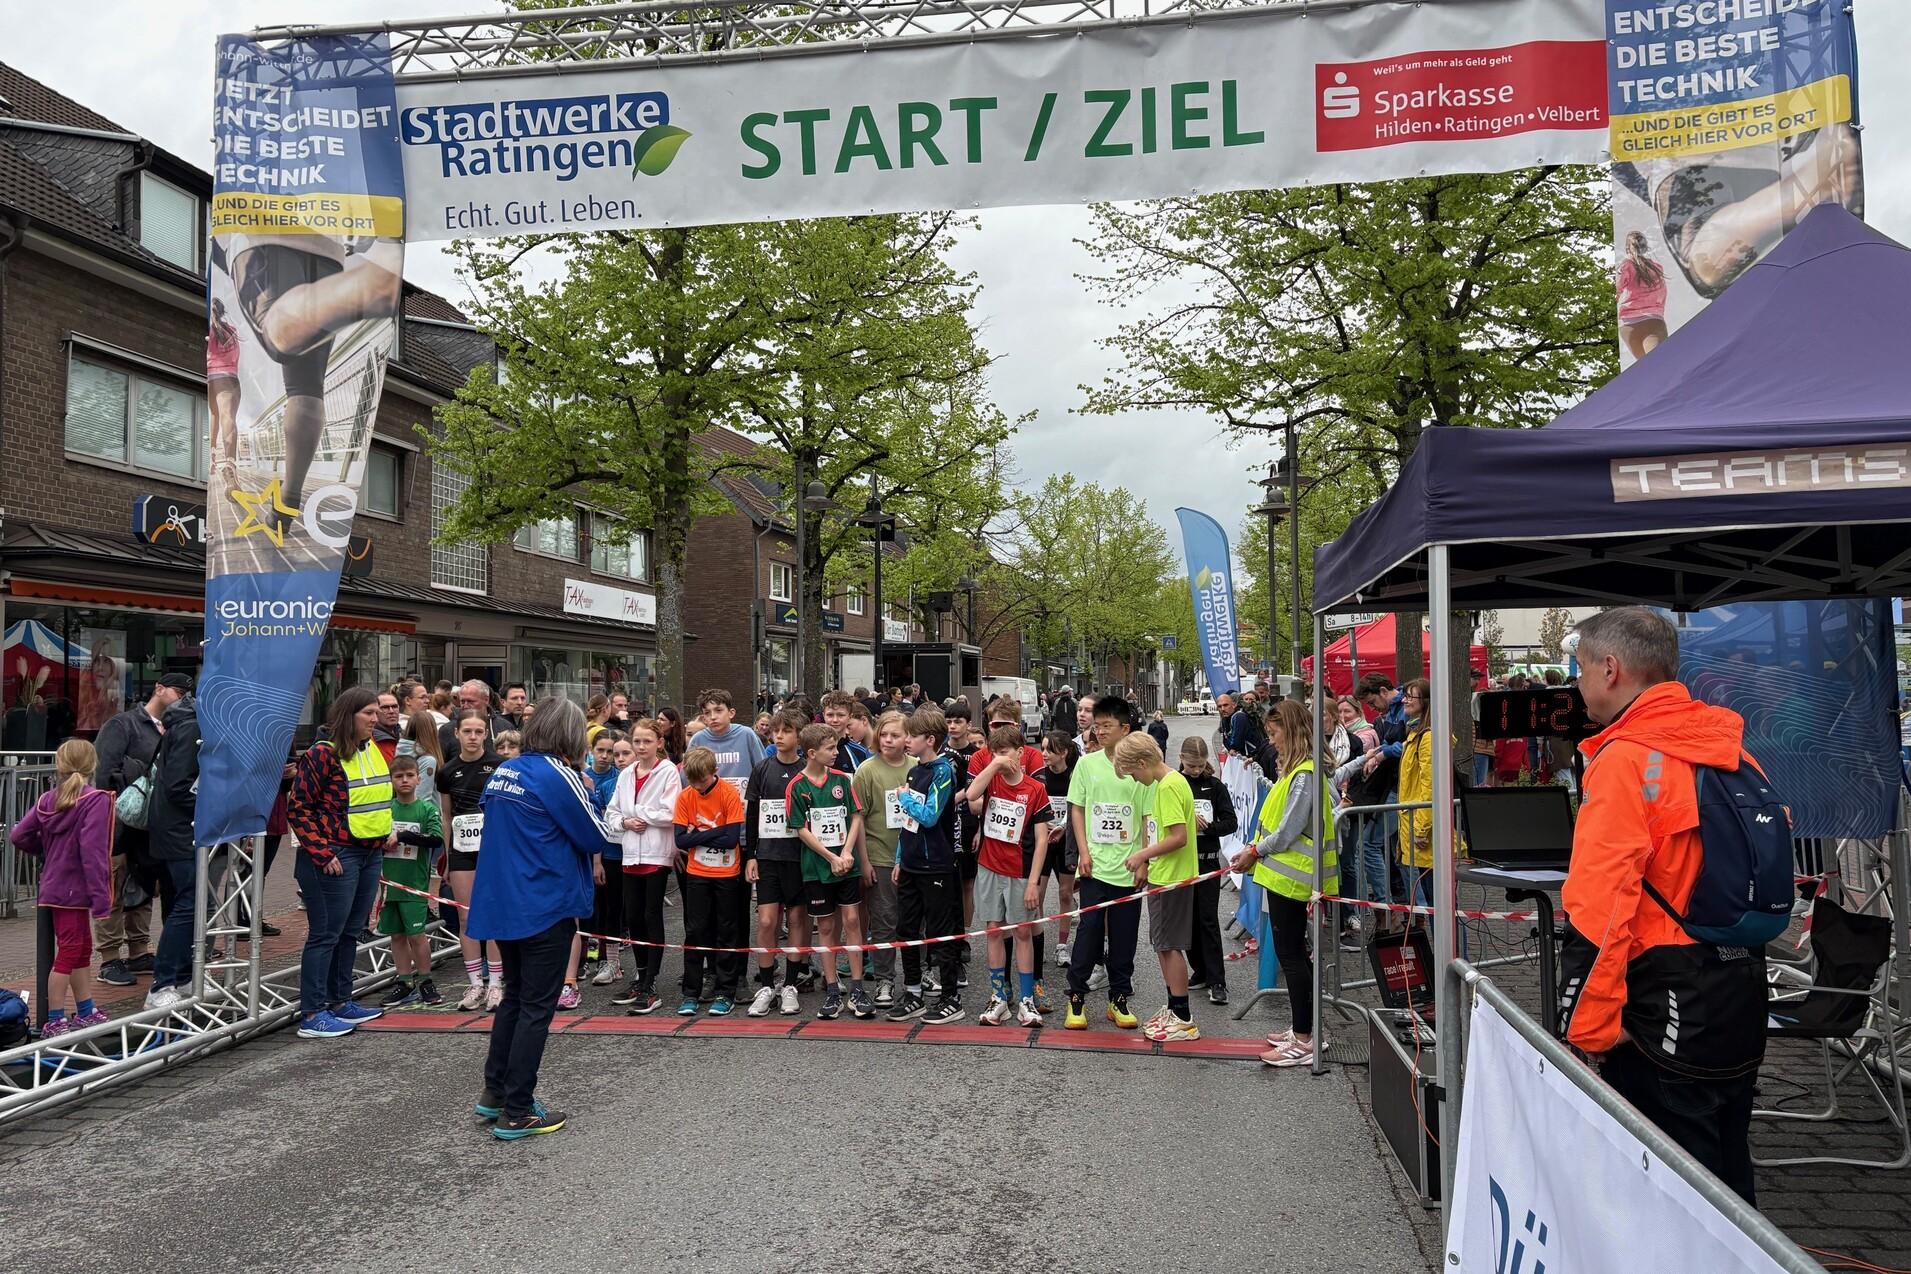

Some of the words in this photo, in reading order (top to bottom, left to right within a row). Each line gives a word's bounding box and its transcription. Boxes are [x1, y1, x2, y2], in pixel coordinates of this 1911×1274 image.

[1617, 42, 1667, 69] DIE
[1675, 27, 1781, 63] BESTE
[1374, 62, 1403, 76] Weil's
[1405, 60, 1421, 70] um
[1423, 57, 1448, 69] mehr
[1450, 57, 1463, 67] als
[1465, 56, 1487, 67] Geld
[1489, 54, 1513, 66] geht
[1618, 64, 1760, 102] TECHNIK
[1374, 83, 1514, 117] Sparkasse
[408, 94, 661, 144] Stadtwerke
[740, 96, 998, 180] START
[1024, 93, 1057, 162] /
[1084, 80, 1265, 158] ZIEL
[1375, 118, 1432, 139] Hilden
[1444, 111, 1525, 133] Ratingen
[1537, 105, 1601, 122] Velbert
[1622, 118, 1670, 135] ...UND
[1675, 114, 1701, 129] DIE
[1707, 108, 1747, 125] GIBT
[1753, 103, 1776, 117] ES
[1623, 135, 1682, 152] GLEICH
[1687, 130, 1728, 146] HIER
[1730, 121, 1773, 141] VOR
[1779, 109, 1817, 130] ORT
[260, 136, 344, 160] BESTE
[441, 137, 633, 182] Ratingen
[252, 199, 278, 210] DIE
[282, 200, 316, 212] GIBT
[321, 200, 340, 211] ES
[263, 214, 299, 227] HIER
[304, 215, 338, 228] VOR
[342, 217, 374, 229] ORT
[445, 202, 500, 230] Echt.
[505, 200, 555, 226] Gut.
[561, 195, 642, 222] Leben.
[1619, 448, 1907, 493] TEAMS
[565, 586, 584, 609] TAX
[623, 597, 639, 618] TAX
[1327, 618, 1336, 626] Sa
[1502, 693, 1600, 731] 11:2
[715, 752, 740, 763] UMA
[822, 823, 841, 834] 231
[990, 813, 1017, 827] 3093
[1102, 820, 1123, 830] 232
